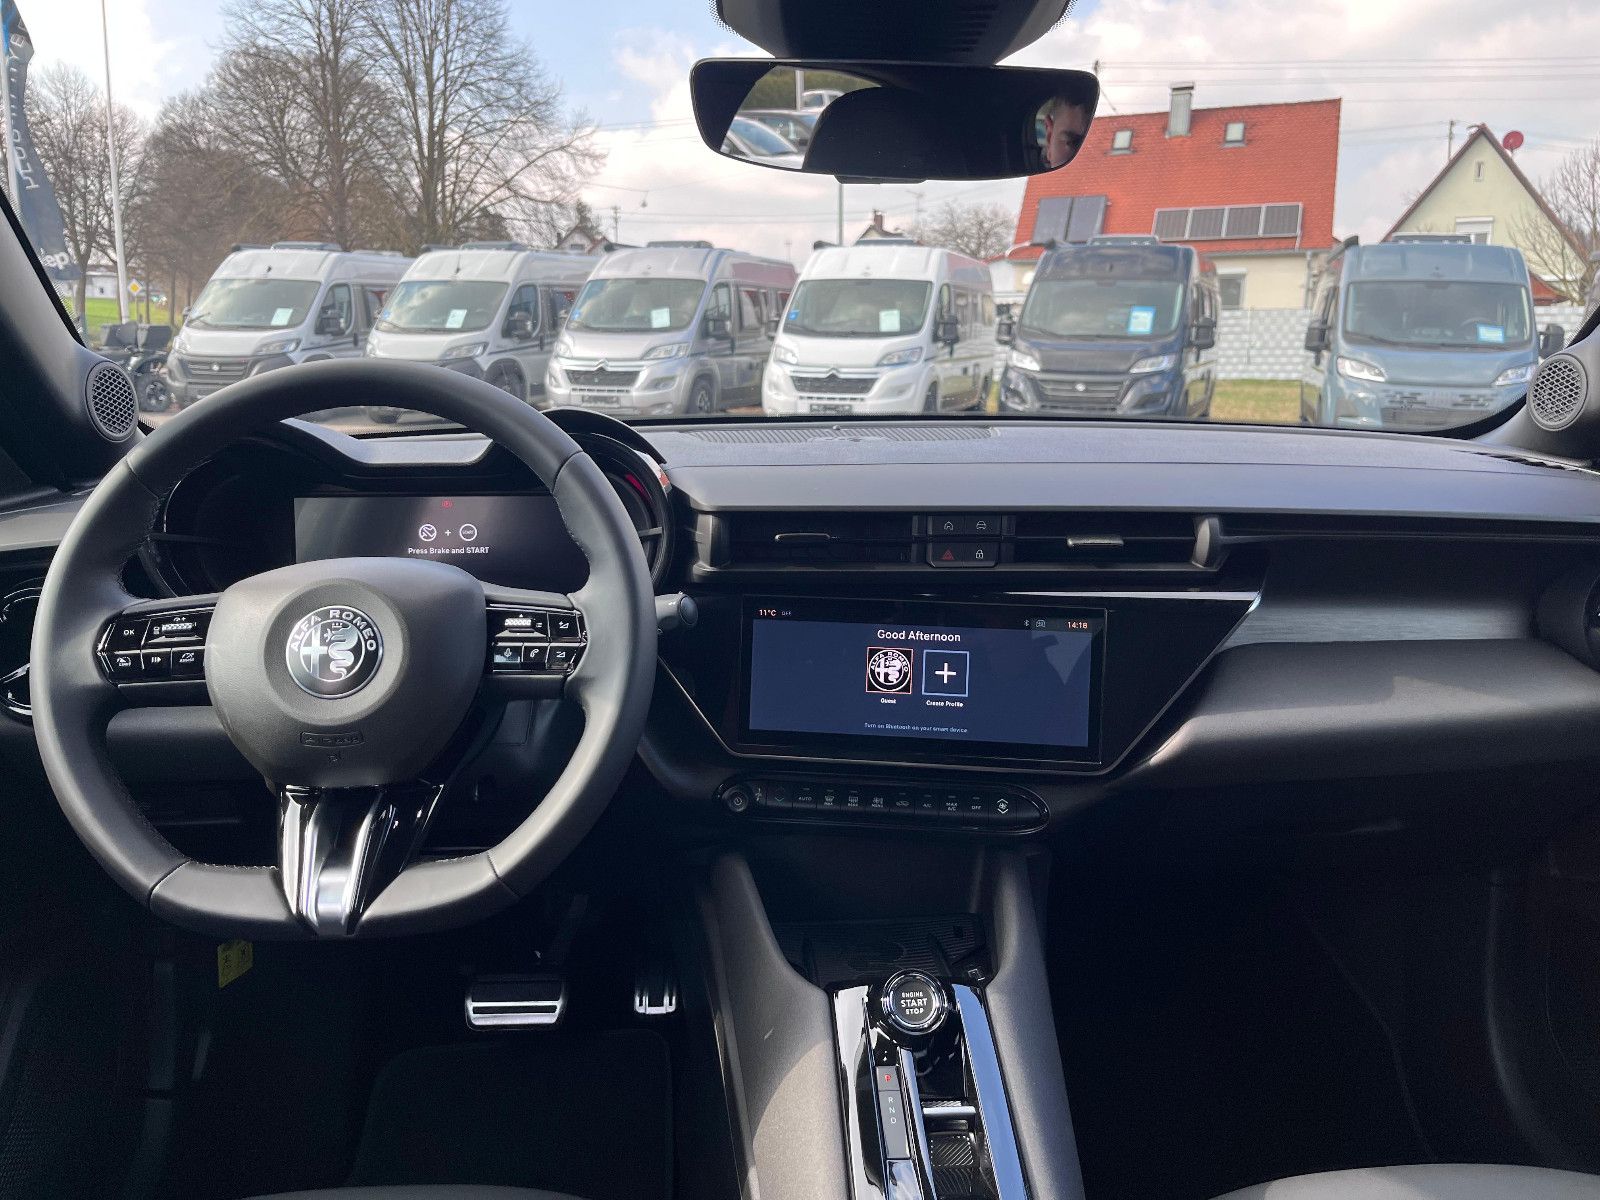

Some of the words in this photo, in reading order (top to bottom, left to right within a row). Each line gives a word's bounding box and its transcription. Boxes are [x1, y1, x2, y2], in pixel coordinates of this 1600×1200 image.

[408, 547, 428, 555] Press
[466, 546, 490, 554] START
[759, 609, 777, 617] 11°C
[290, 615, 322, 653] ALFA
[329, 609, 377, 651] ROMEO
[877, 629, 906, 640] Good
[907, 630, 961, 642] Afternoon
[945, 700, 964, 708] Profile
[900, 998, 928, 1007] START
[884, 1074, 892, 1082] P
